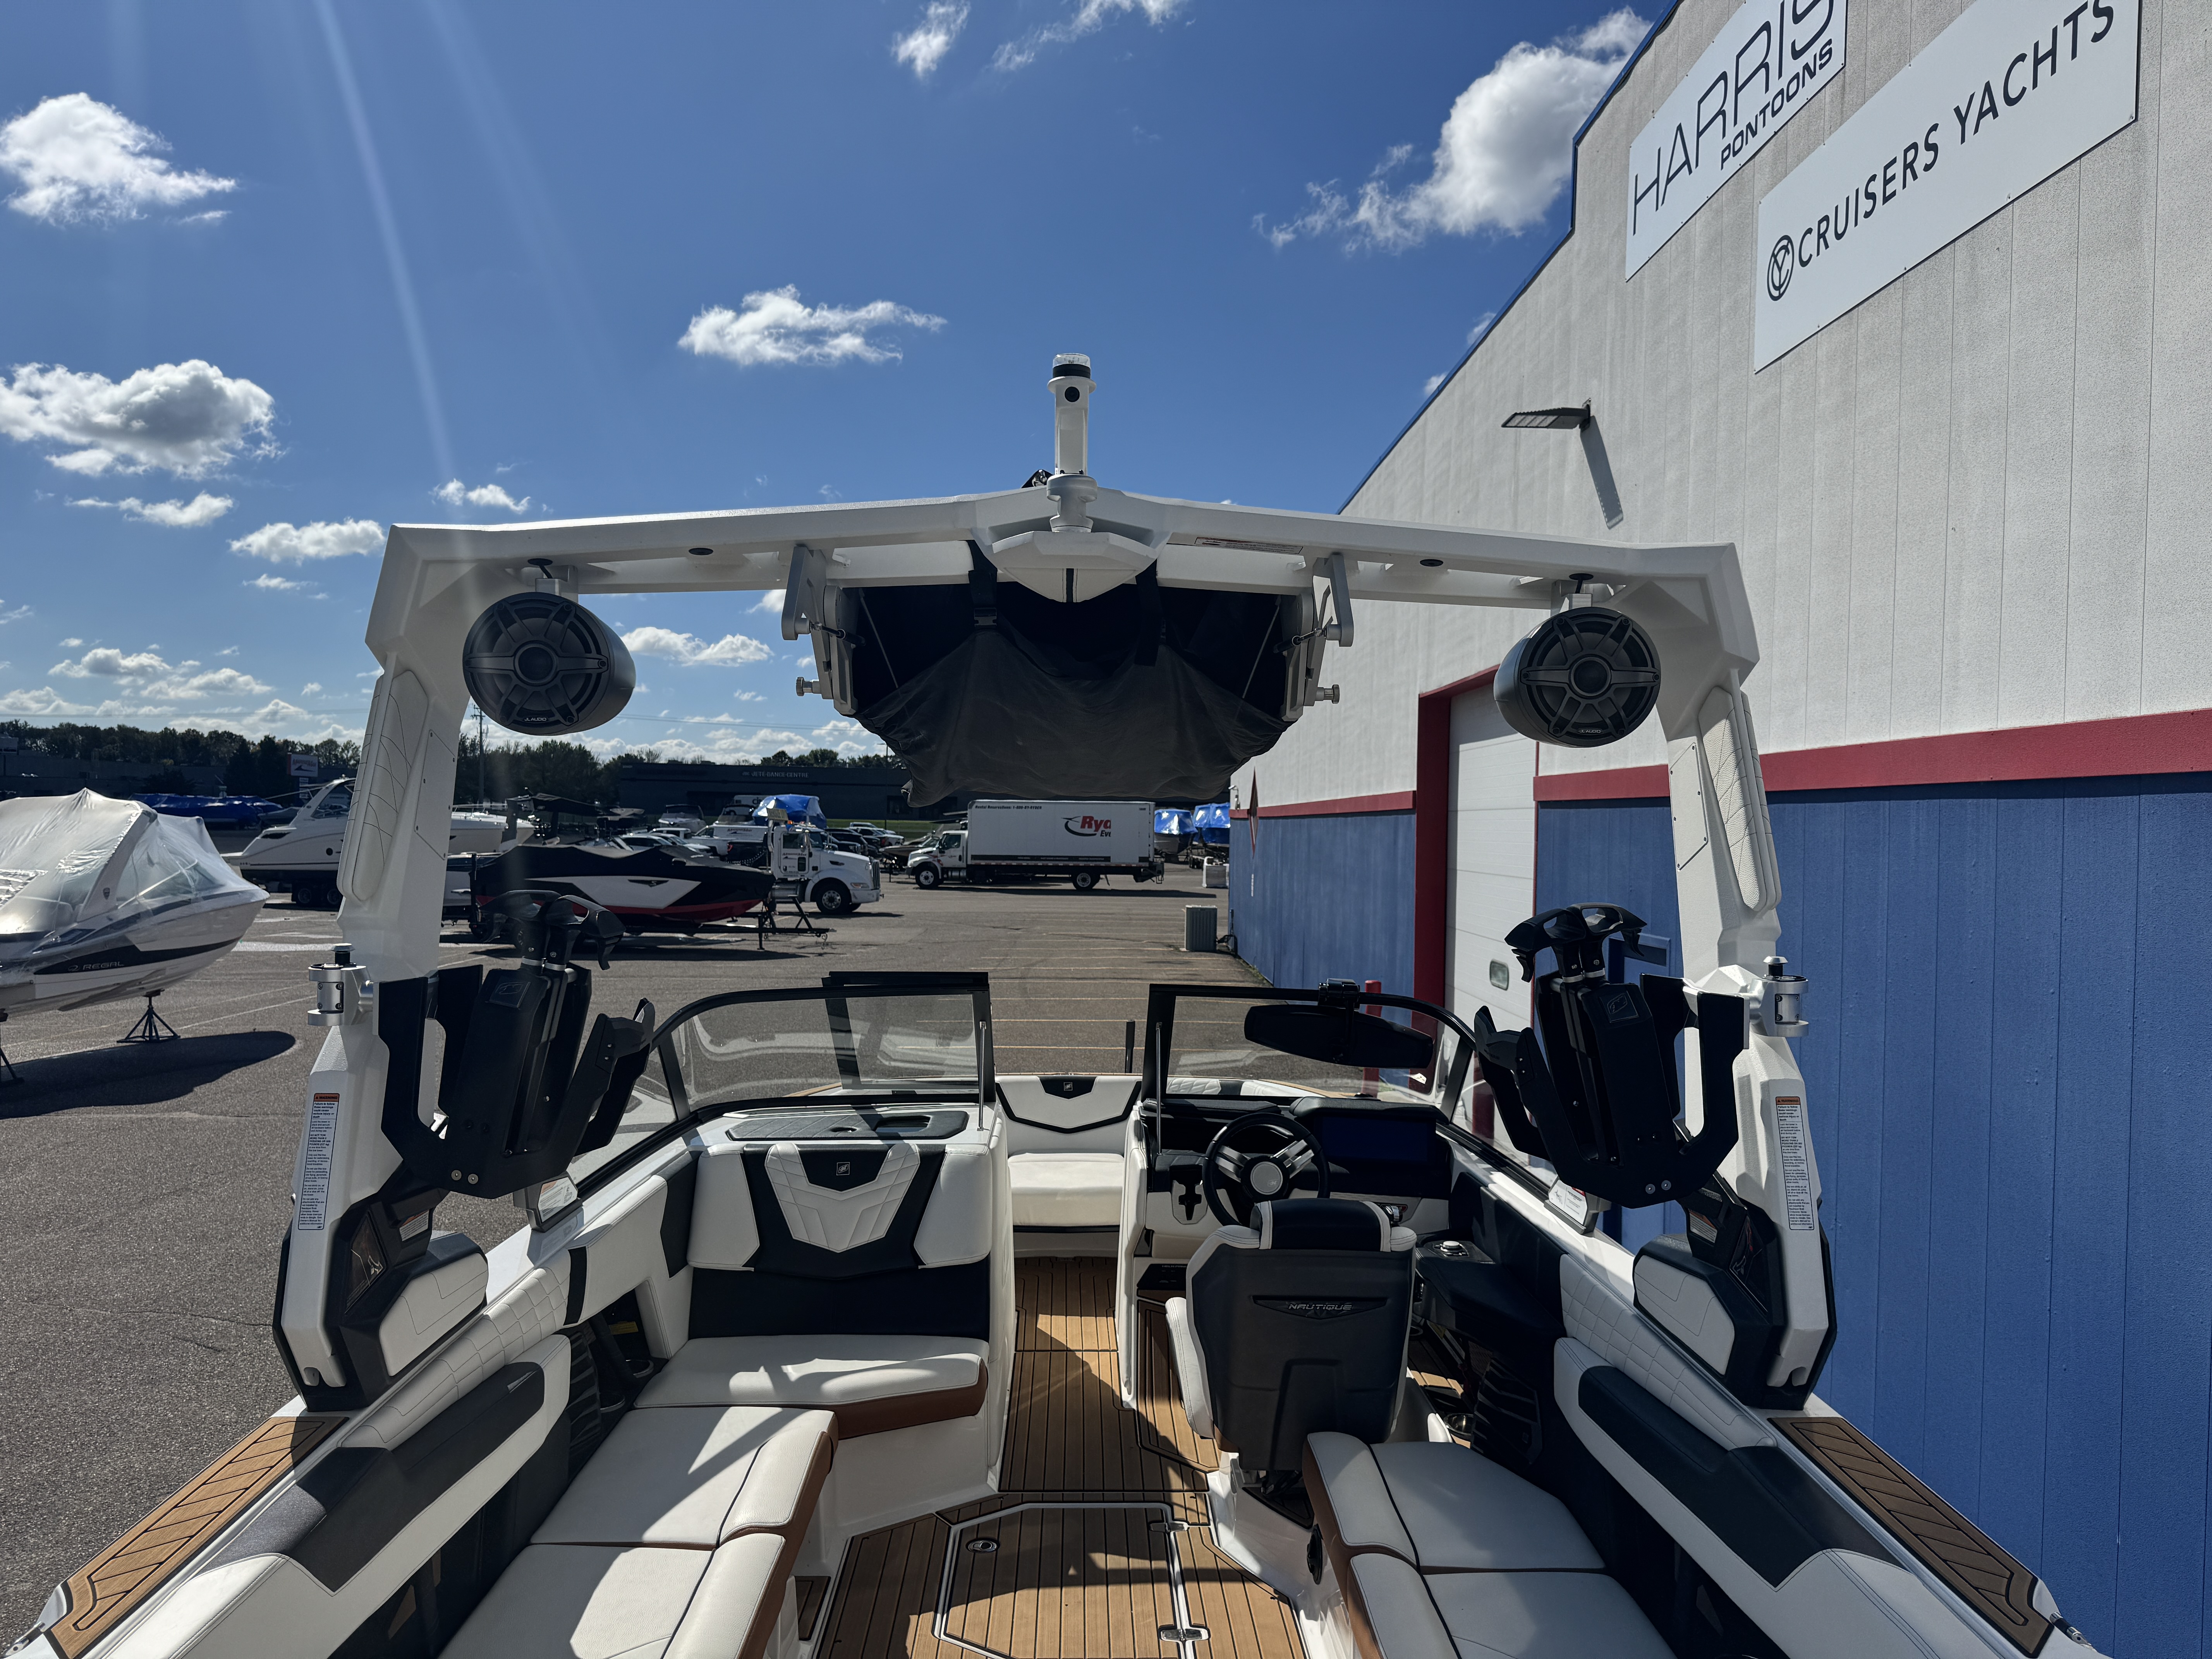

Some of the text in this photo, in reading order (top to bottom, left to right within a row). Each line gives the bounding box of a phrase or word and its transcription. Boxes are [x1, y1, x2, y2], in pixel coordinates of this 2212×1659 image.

[1633, 0, 1834, 236] HARRIS
[1721, 38, 1832, 171] PONTOONS
[1798, 123, 1939, 267] CRUISERS
[1953, 0, 2114, 145] YACHTS
[82, 961, 125, 970] REGAL
